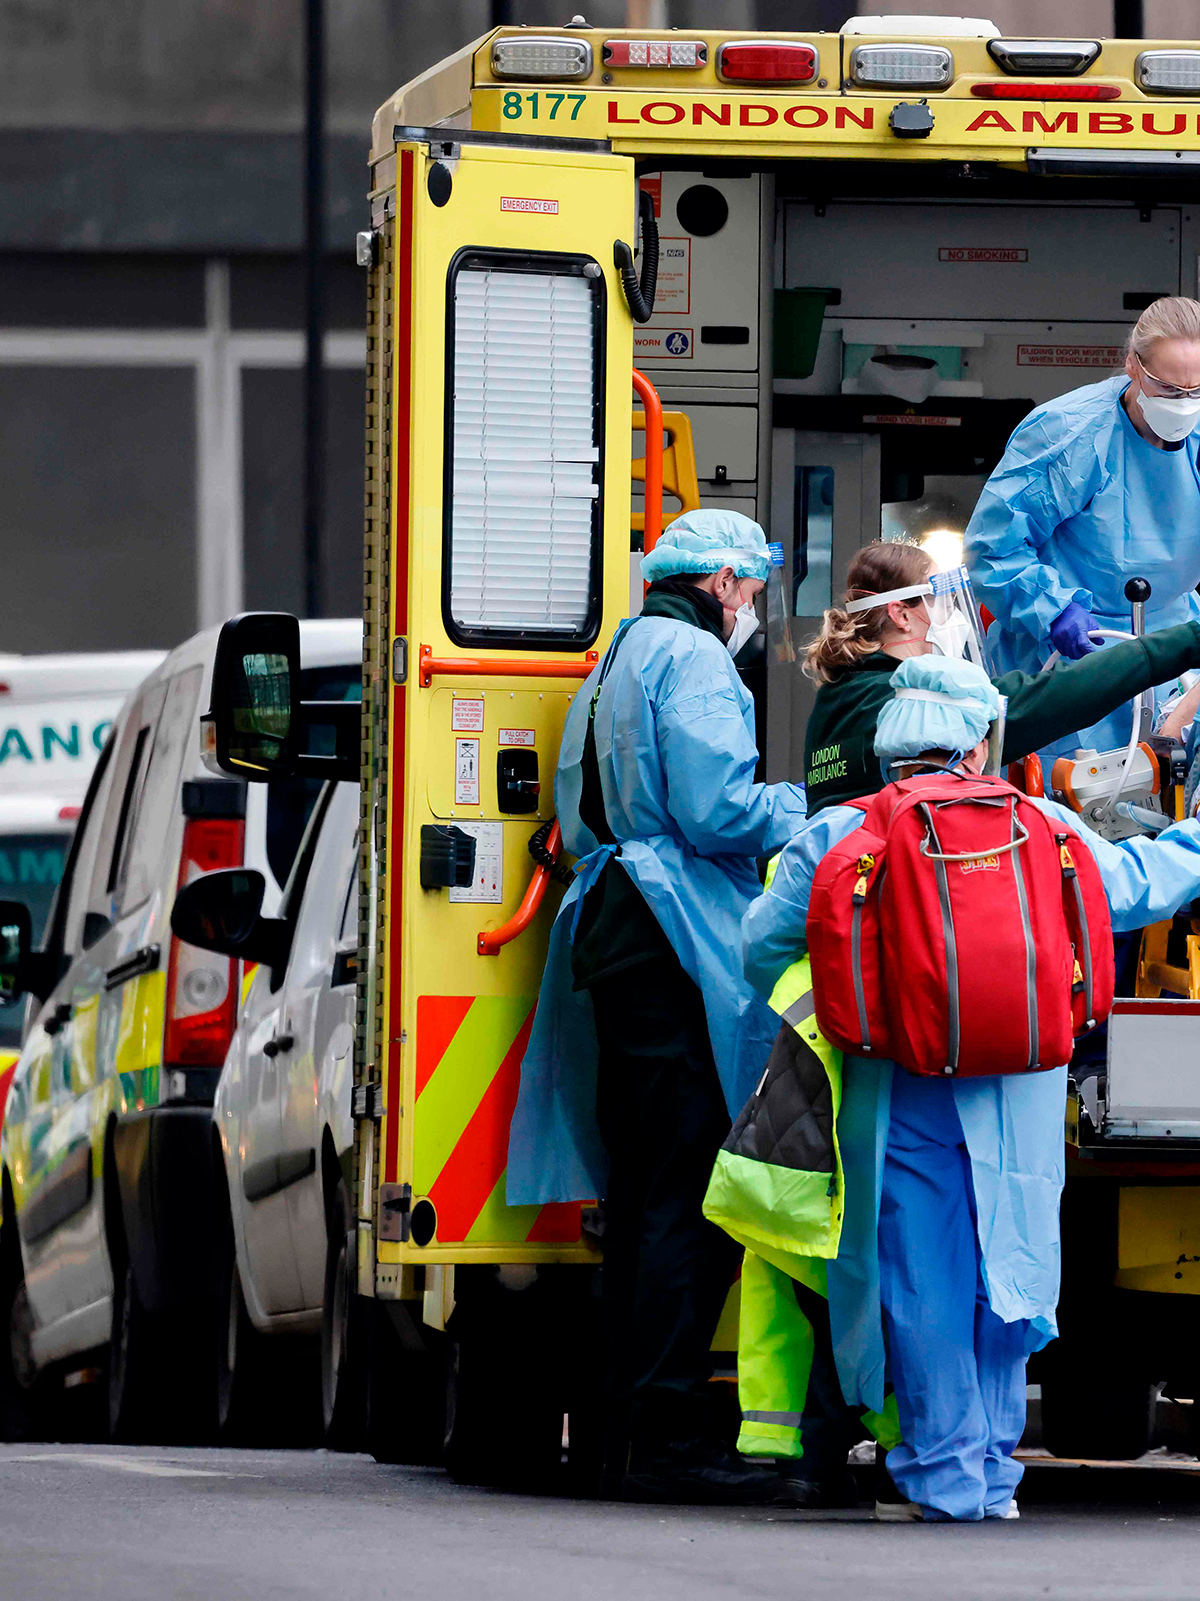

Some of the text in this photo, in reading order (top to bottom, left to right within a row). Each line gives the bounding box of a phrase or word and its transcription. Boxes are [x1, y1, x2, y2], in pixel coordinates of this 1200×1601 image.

[502, 92, 586, 121] 8177
[607, 101, 874, 130] LONDON
[503, 200, 556, 211] EMERGENCY EXIT
[667, 249, 684, 257] NHS
[948, 250, 1019, 260] NO SMOKING
[634, 338, 661, 347] WORN
[1020, 347, 1054, 356] SLIDING
[1056, 348, 1081, 357] DOOR
[1107, 349, 1118, 357] BE
[1028, 356, 1053, 364] WHEN
[1055, 356, 1090, 365] VEHICLE
[1092, 357, 1100, 365] IS
[1101, 357, 1110, 365] IN
[876, 415, 947, 425] MIND YOUR HEAD
[811, 744, 840, 767] LONDON
[807, 760, 847, 787] AMBULANCE
